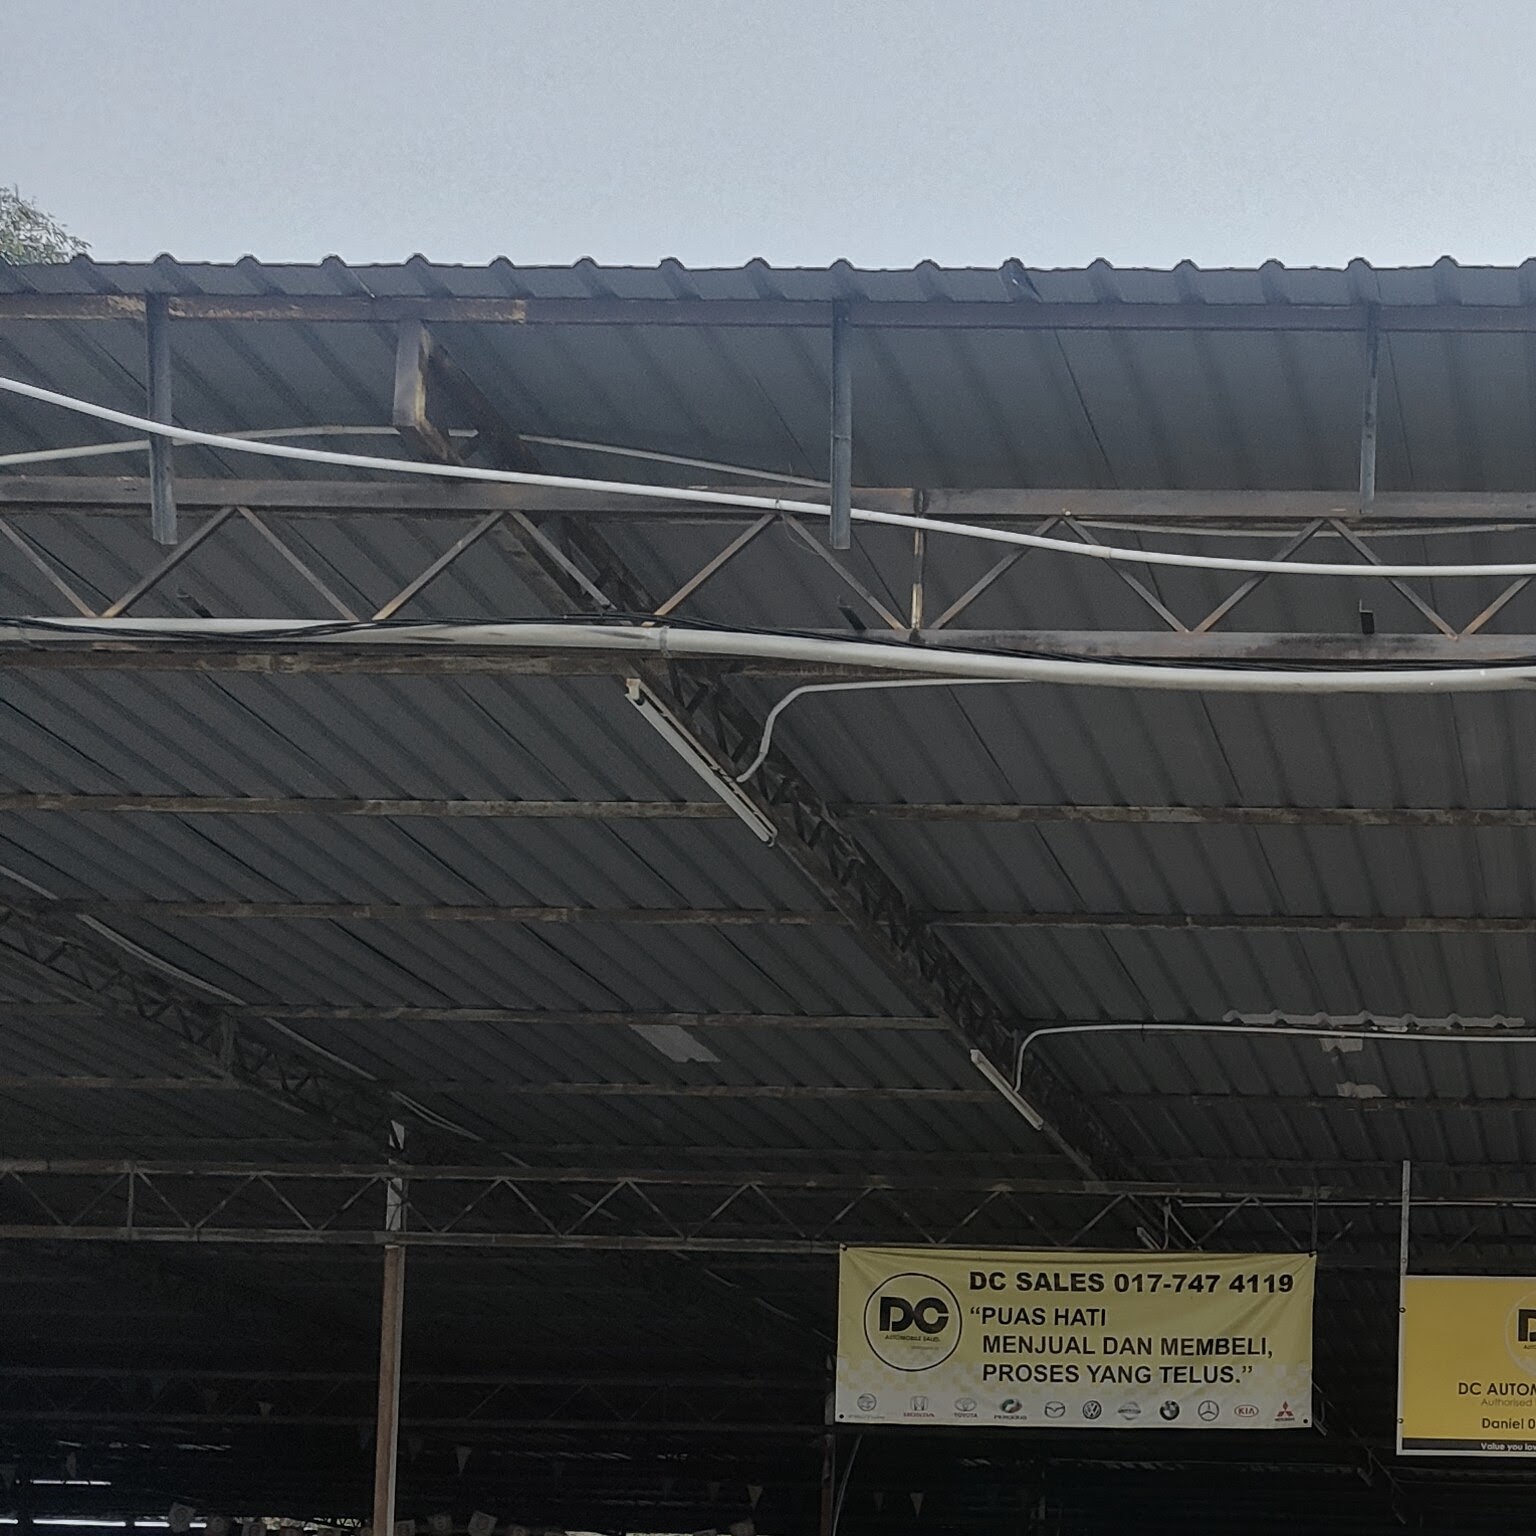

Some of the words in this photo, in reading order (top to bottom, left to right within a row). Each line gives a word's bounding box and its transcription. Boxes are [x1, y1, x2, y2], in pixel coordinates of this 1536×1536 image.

[969, 1271, 1006, 1293] DC
[1016, 1272, 1104, 1293] SALES
[1113, 1273, 1220, 1293] 017-747
[1229, 1274, 1294, 1294] 4119
[879, 1296, 949, 1335] DC
[1054, 1308, 1106, 1327] HATI
[982, 1335, 1095, 1355] MENJUAL
[1103, 1337, 1152, 1355] DAN
[1160, 1337, 1273, 1359] MEMBELI,
[982, 1365, 1079, 1384] PROSES
[1087, 1366, 1151, 1384] YANG
[1458, 1382, 1482, 1396] DC
[1482, 1418, 1524, 1430] Daniel
[1481, 1442, 1505, 1451] Value
[1507, 1444, 1523, 1453] you
